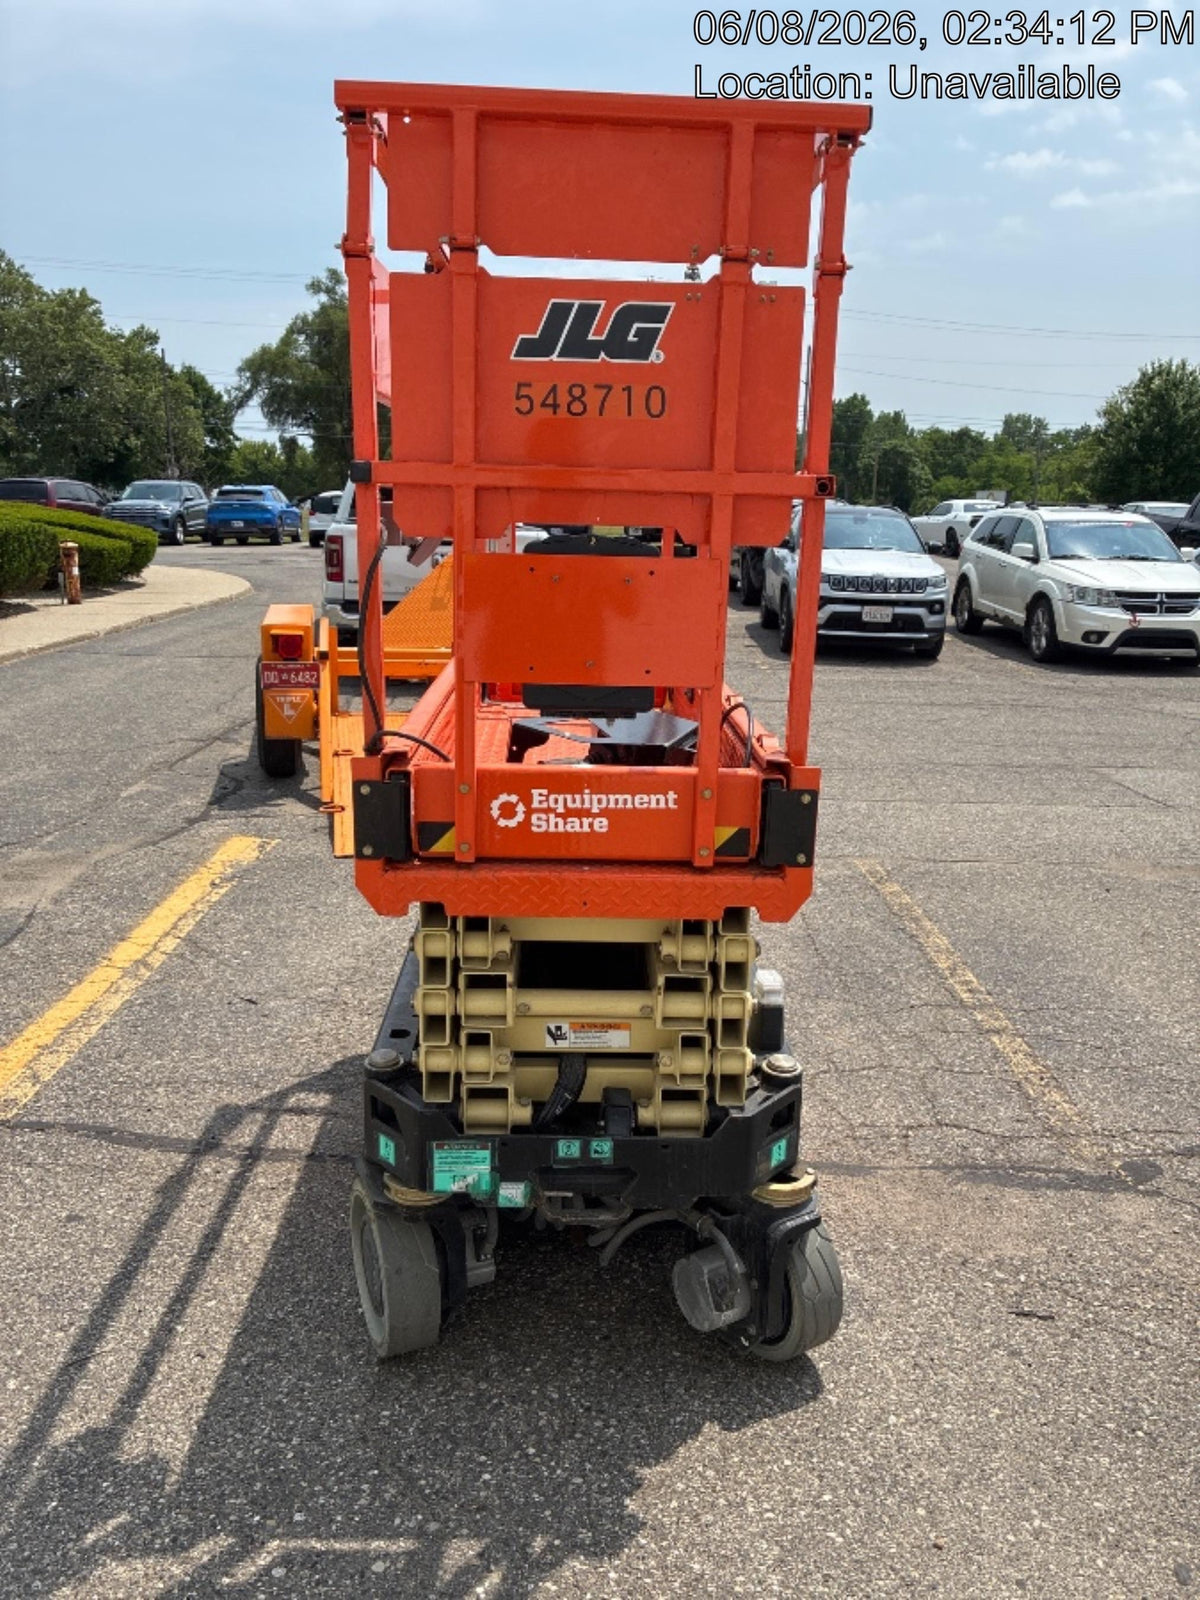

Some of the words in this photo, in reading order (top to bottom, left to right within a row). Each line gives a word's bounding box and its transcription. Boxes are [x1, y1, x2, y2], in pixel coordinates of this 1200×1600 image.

[510, 298, 676, 363] JLG
[514, 381, 667, 419] 548710
[530, 789, 678, 813] Equipment
[530, 813, 609, 832] Share
